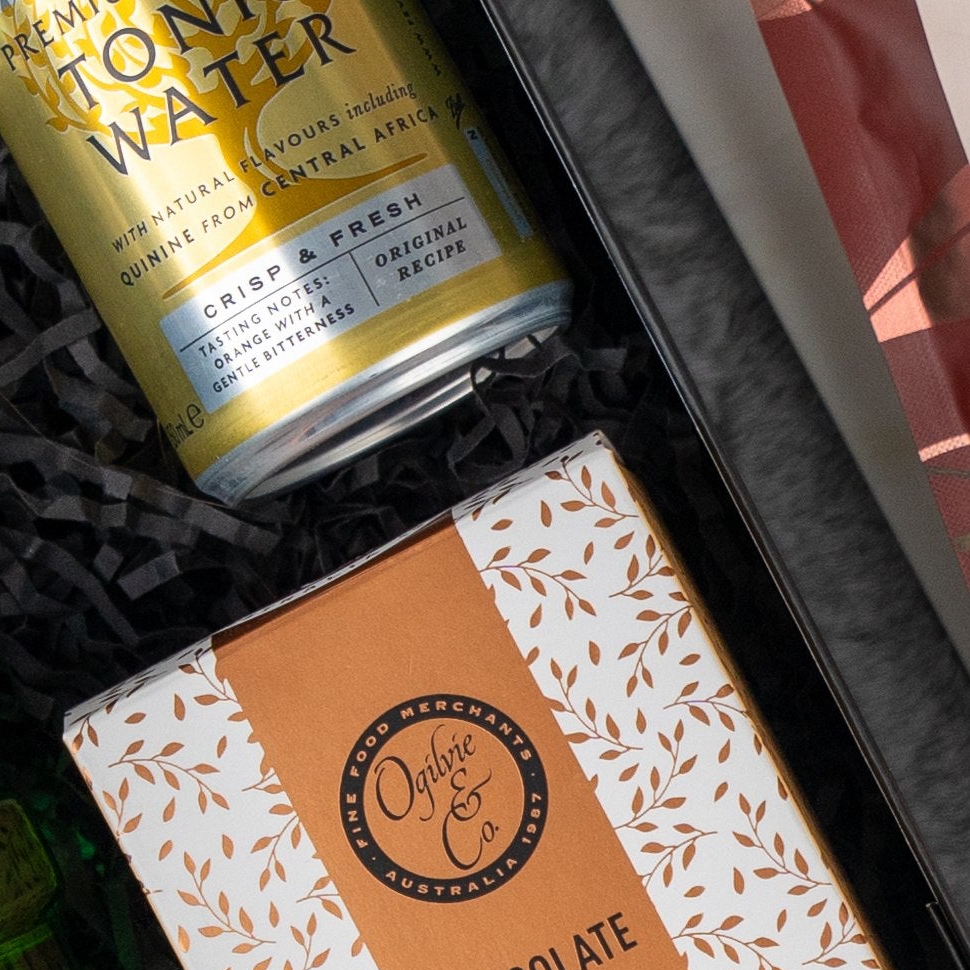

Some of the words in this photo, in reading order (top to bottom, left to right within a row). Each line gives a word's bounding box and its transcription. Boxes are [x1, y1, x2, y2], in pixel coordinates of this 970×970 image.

[0, 0, 120, 71] PREMI
[86, 13, 357, 176] WATER
[112, 221, 148, 254] WITH
[152, 171, 236, 227] NATURAL
[239, 115, 341, 175] FLAVOURS
[346, 81, 417, 120] including
[120, 229, 195, 287] QUININE
[202, 194, 255, 234] FROM
[261, 140, 367, 198] CENTRAL
[373, 105, 439, 144] AFRICA
[204, 264, 282, 319] CRISP
[298, 248, 317, 264] &
[330, 192, 423, 248] FRESH
[375, 216, 468, 268] ORIGINAL
[397, 239, 467, 282] RECIPE
[198, 312, 261, 358] TASTING
[267, 275, 330, 317] NOTES:
[212, 356, 260, 393] GENTLE
[264, 302, 355, 361] BITTERNESS
[214, 327, 271, 370] ORANGE
[274, 304, 315, 332] WITH
[321, 294, 332, 309] A
[350, 722, 389, 778] FOOD
[400, 700, 532, 761] MERCHANTS
[374, 724, 477, 821] Ogilvie
[450, 768, 493, 821] &
[345, 792, 368, 849] FINE
[385, 857, 518, 896] AUSTRALIA
[521, 793, 542, 845] 1987
[442, 810, 499, 871] Co.
